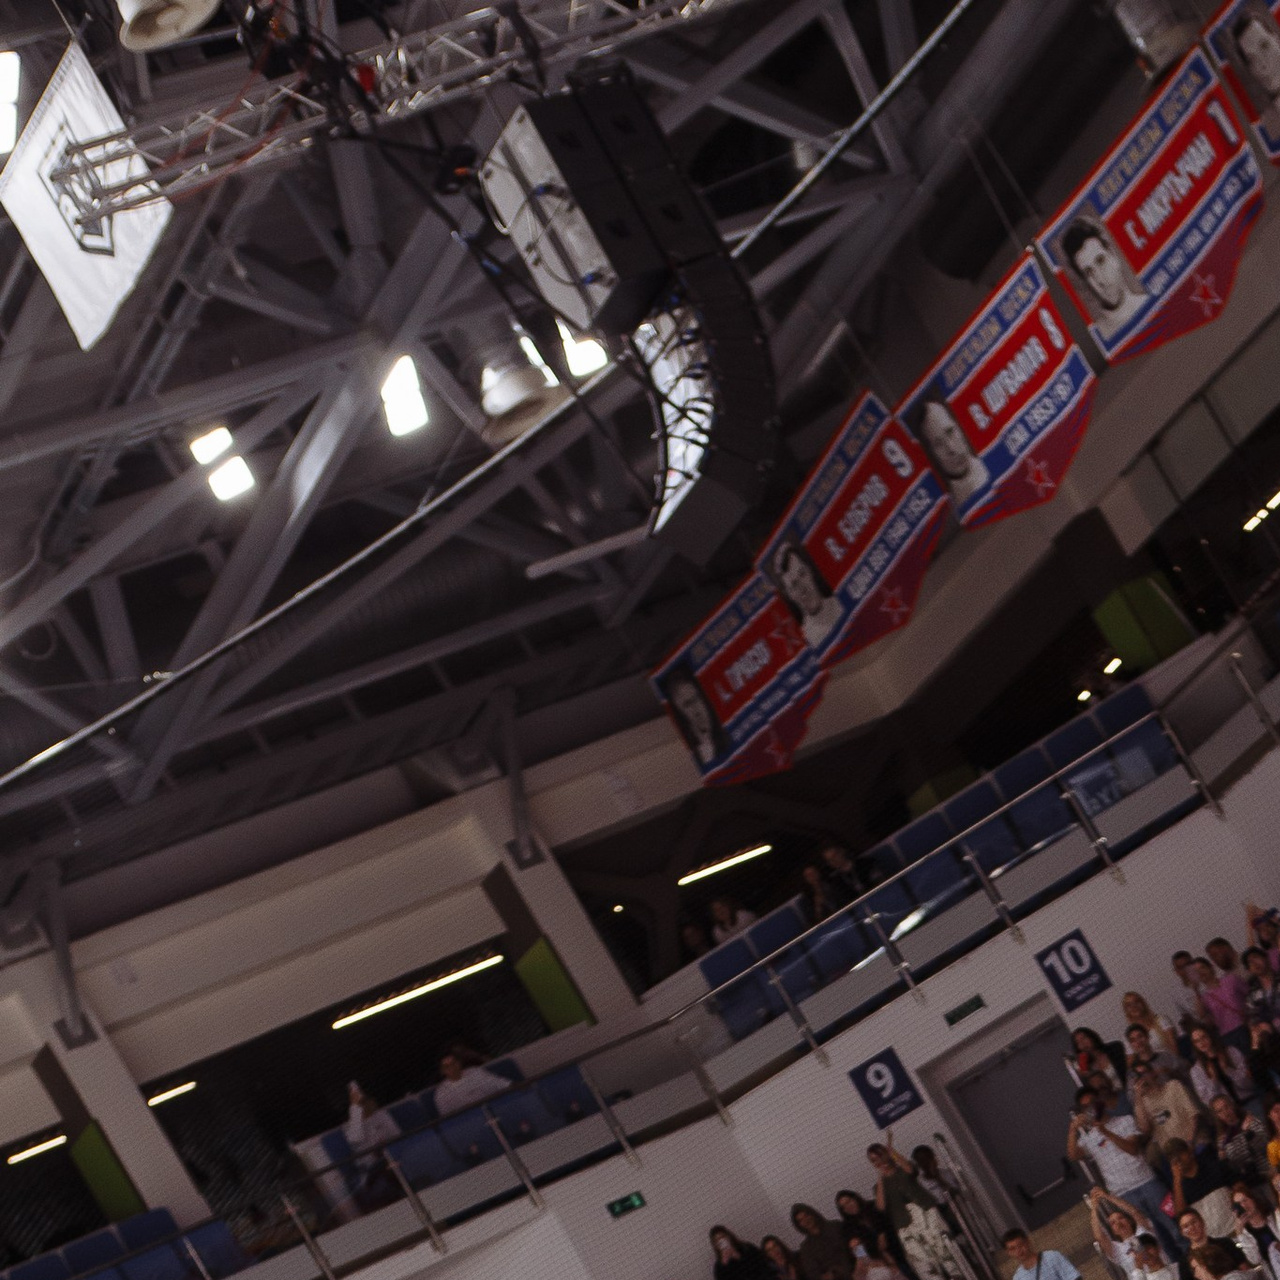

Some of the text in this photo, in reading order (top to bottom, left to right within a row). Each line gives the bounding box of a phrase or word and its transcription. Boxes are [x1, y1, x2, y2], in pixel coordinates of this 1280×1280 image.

[1206, 99, 1239, 145] 1
[881, 437, 916, 479] 9
[1042, 937, 1093, 986] 10
[865, 1060, 897, 1100] 9
